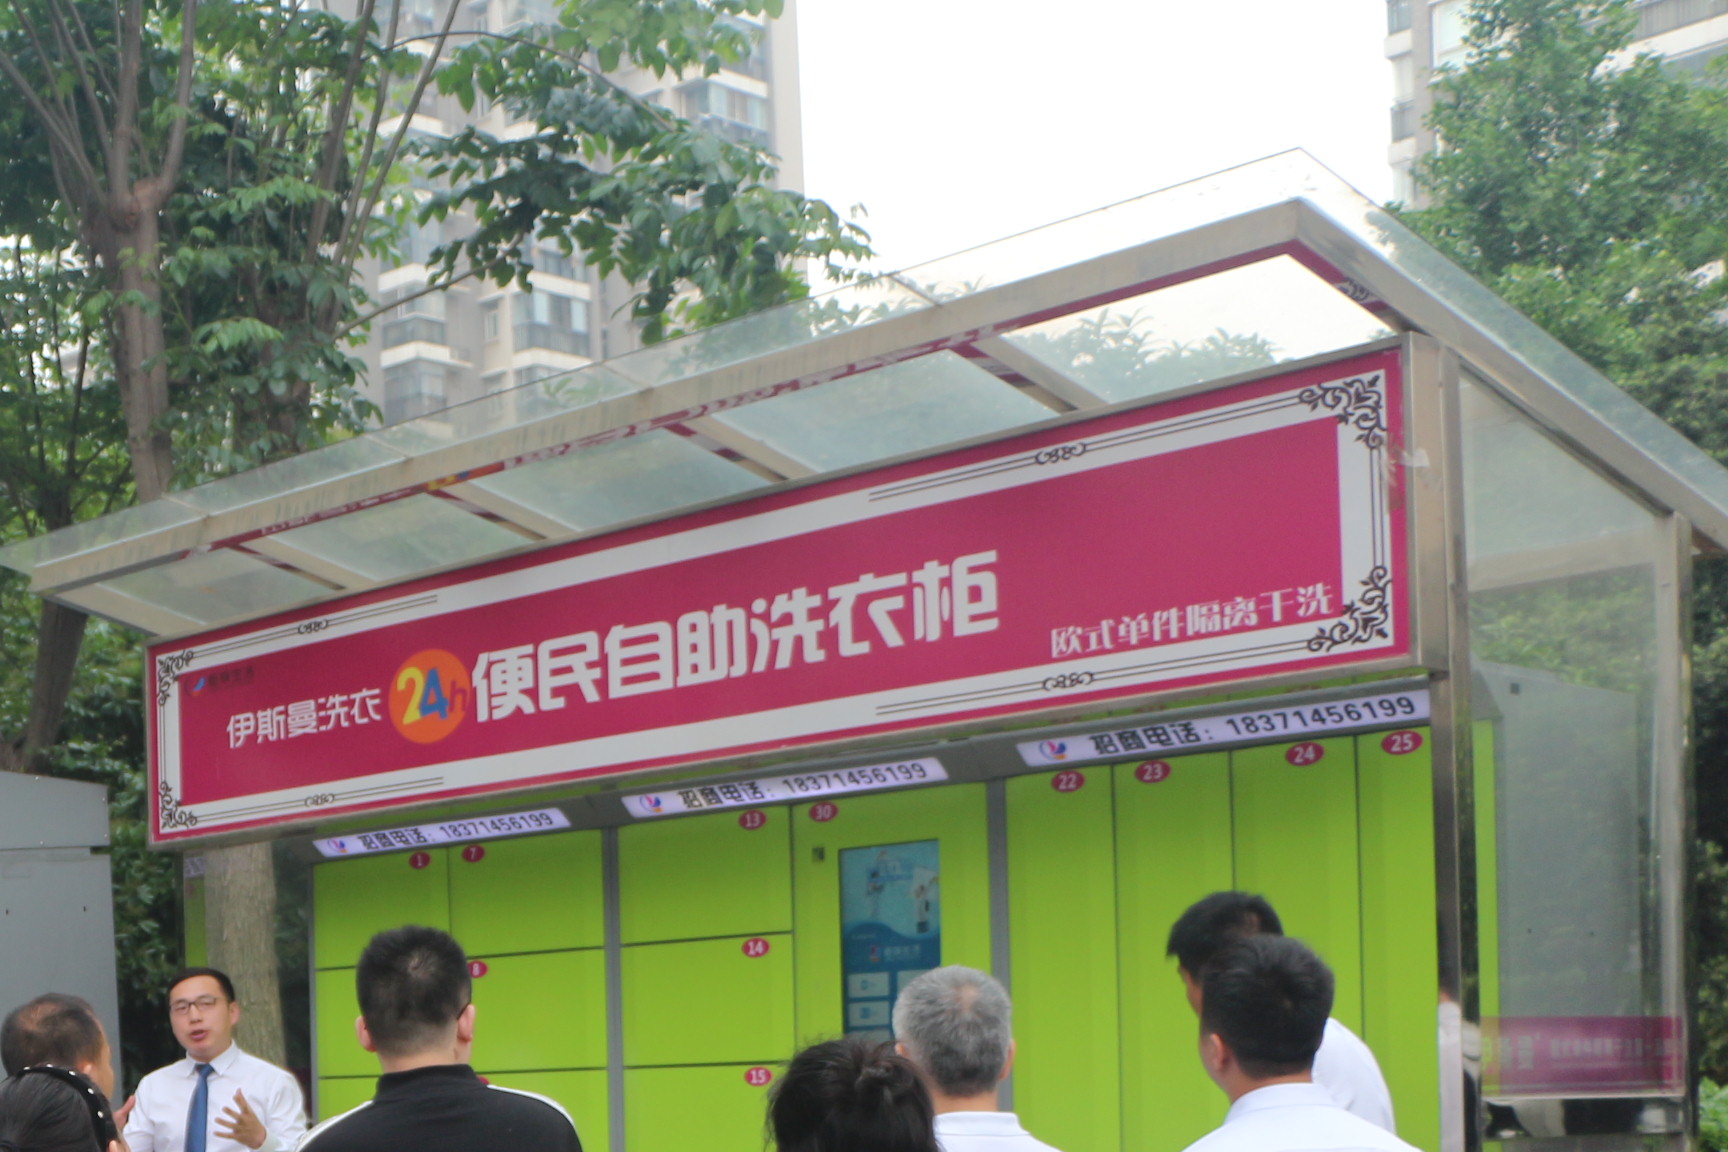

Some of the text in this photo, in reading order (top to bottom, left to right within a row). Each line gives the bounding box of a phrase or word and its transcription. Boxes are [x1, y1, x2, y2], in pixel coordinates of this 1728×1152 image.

[226, 687, 382, 748] 伊斯曼洗衣
[471, 549, 1000, 722] 便民自助洗衣柜
[1050, 582, 1333, 658] 欧式单件隔离干洗
[1391, 733, 1414, 752] 25
[1294, 745, 1316, 764] 24
[1143, 763, 1163, 781] 23
[1058, 773, 1077, 789] 22
[814, 804, 833, 819] 30
[745, 812, 761, 828] 13
[748, 941, 764, 956] 14
[751, 1069, 766, 1084] 15
